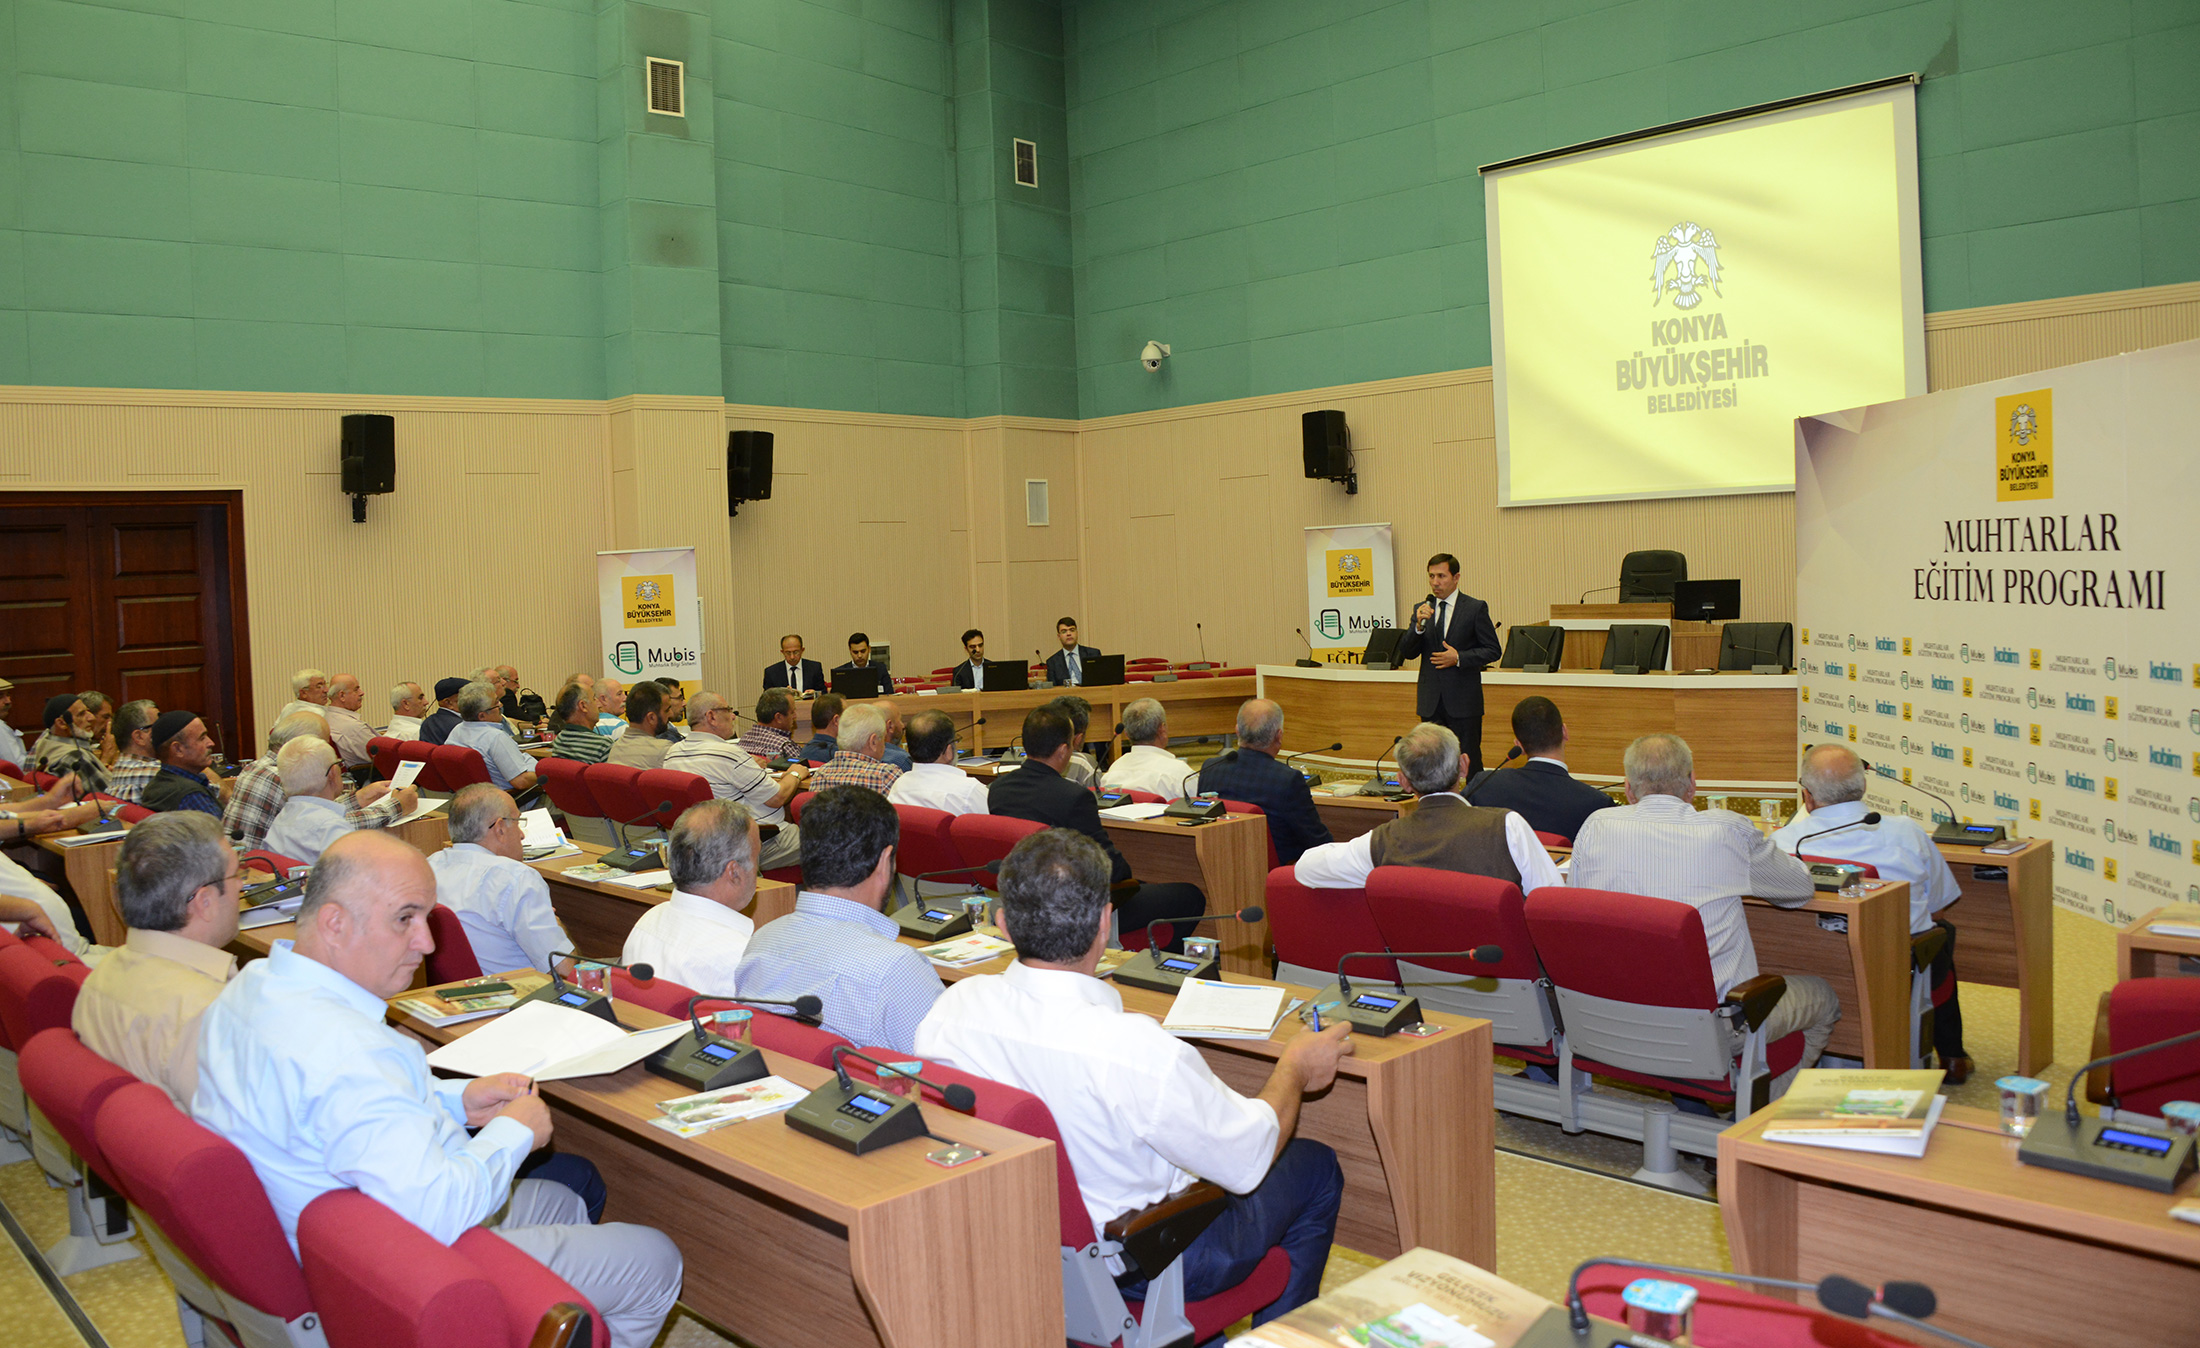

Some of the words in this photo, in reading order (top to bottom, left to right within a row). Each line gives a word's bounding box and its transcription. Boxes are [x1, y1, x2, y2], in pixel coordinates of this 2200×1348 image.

[1652, 313, 1728, 347] KONYA
[1616, 339, 1769, 391] BÜYÜKŞEHİR
[1647, 383, 1737, 415] BELEDİYESİ
[2011, 451, 2036, 463] KONYA
[2000, 462, 2049, 481] BÜYÜKŞEHİR
[1943, 513, 2121, 553] MUHTARLAR
[1913, 558, 1995, 603] EĞİTİM
[2003, 569, 2166, 610] PROGRAMI
[1349, 615, 1391, 629] Mubis
[648, 647, 696, 663] Mubis
[1327, 650, 1366, 664] EĞİT
[2149, 661, 2182, 682] kobim
[2066, 692, 2095, 712] kobim
[2149, 745, 2182, 769] kobim
[2066, 770, 2095, 792] kobim
[2148, 829, 2181, 855] kobim
[2065, 847, 2094, 871] kobim
